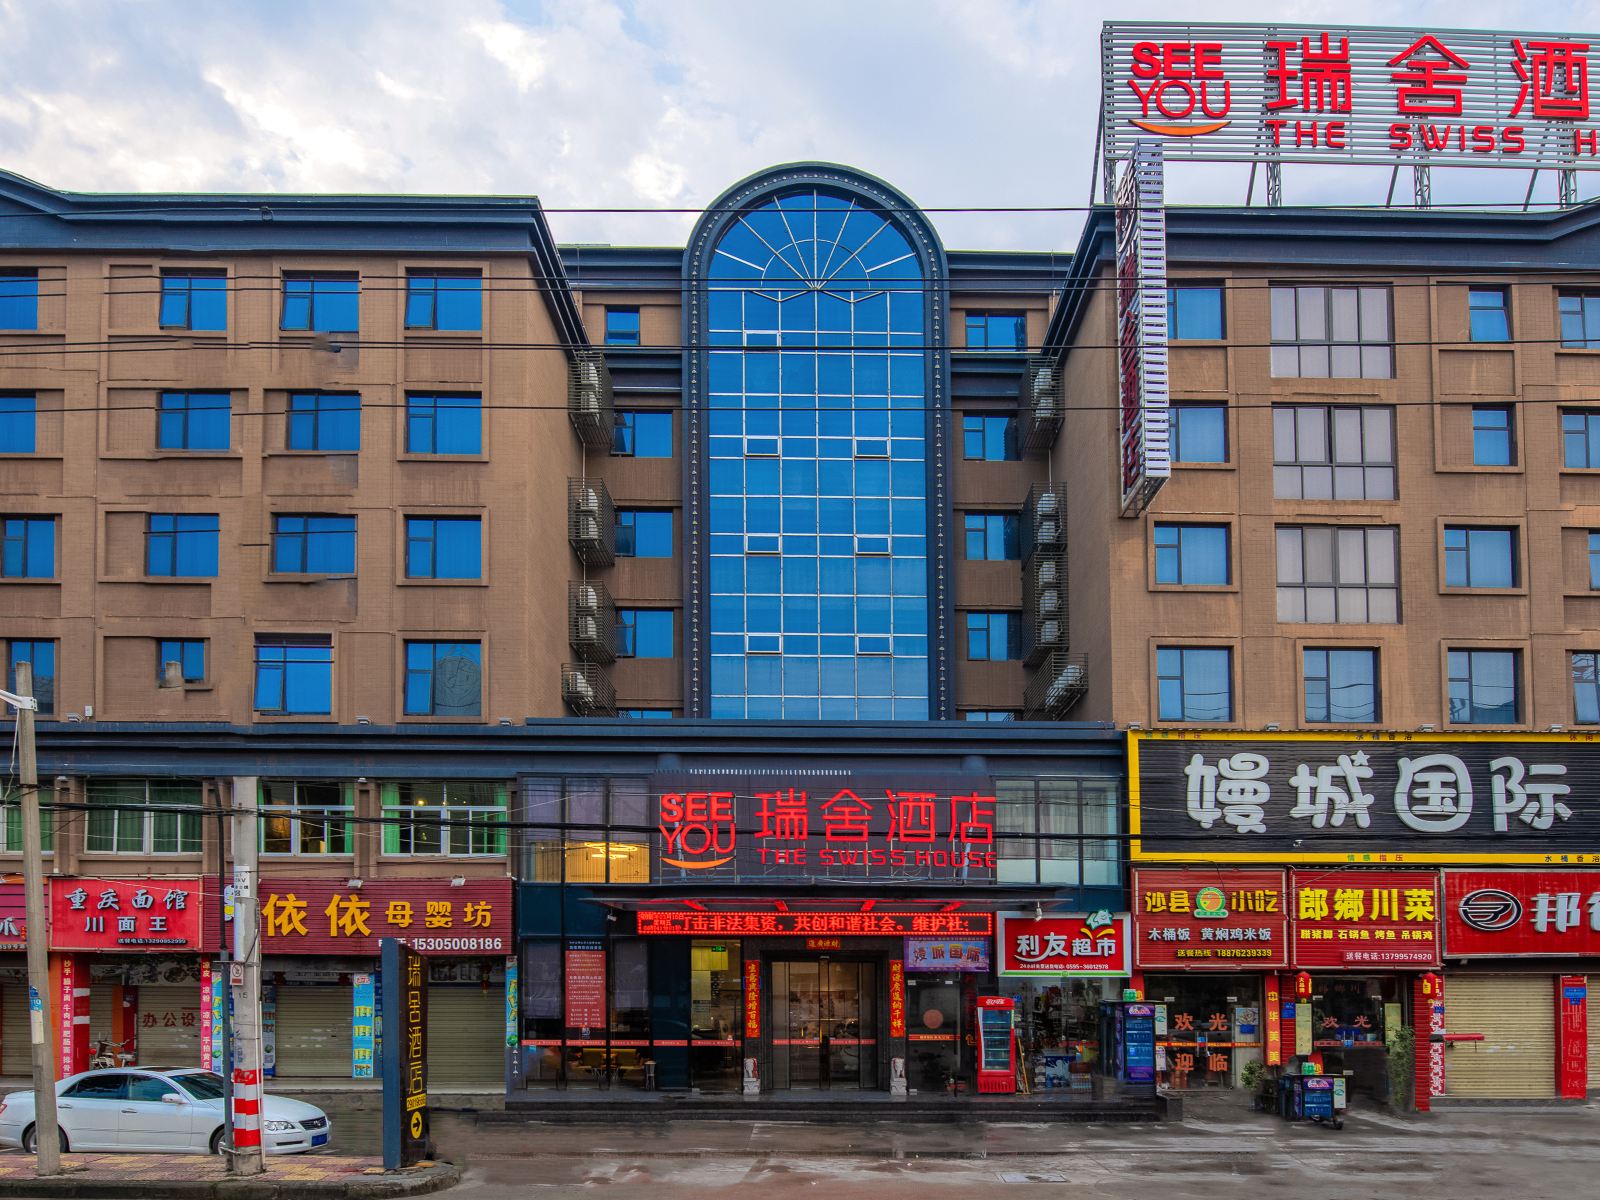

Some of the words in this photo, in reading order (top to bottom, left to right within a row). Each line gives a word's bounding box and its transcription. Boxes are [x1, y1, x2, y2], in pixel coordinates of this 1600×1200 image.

[1131, 42, 1225, 80] SEE
[1266, 32, 1590, 120] 瑞舍酒
[1127, 79, 1231, 118] YOU
[1265, 119, 1346, 149] THE
[1389, 123, 1526, 153] SWISS
[661, 792, 735, 822] SEE
[754, 787, 997, 845] 瑞舍酒店
[658, 823, 736, 855] YOU
[760, 848, 807, 865] THE
[819, 849, 906, 867] SWISS
[914, 850, 998, 869] HOUSE
[64, 887, 188, 910] 重庆面馆
[1144, 890, 1191, 913] 沙县
[1231, 889, 1279, 912] 小吃
[84, 916, 168, 933] 川面王
[261, 893, 493, 937] 依依母婴坊
[412, 937, 502, 951] 15305008186
[1014, 931, 1117, 962] 利友超市
[1148, 927, 1191, 941] 木桶饭
[1201, 927, 1272, 941] 黄焖鸡米饭
[1375, 929, 1396, 940] 烤鱼
[1216, 949, 1272, 957] 18876239339
[142, 1012, 196, 1028] 办公设
